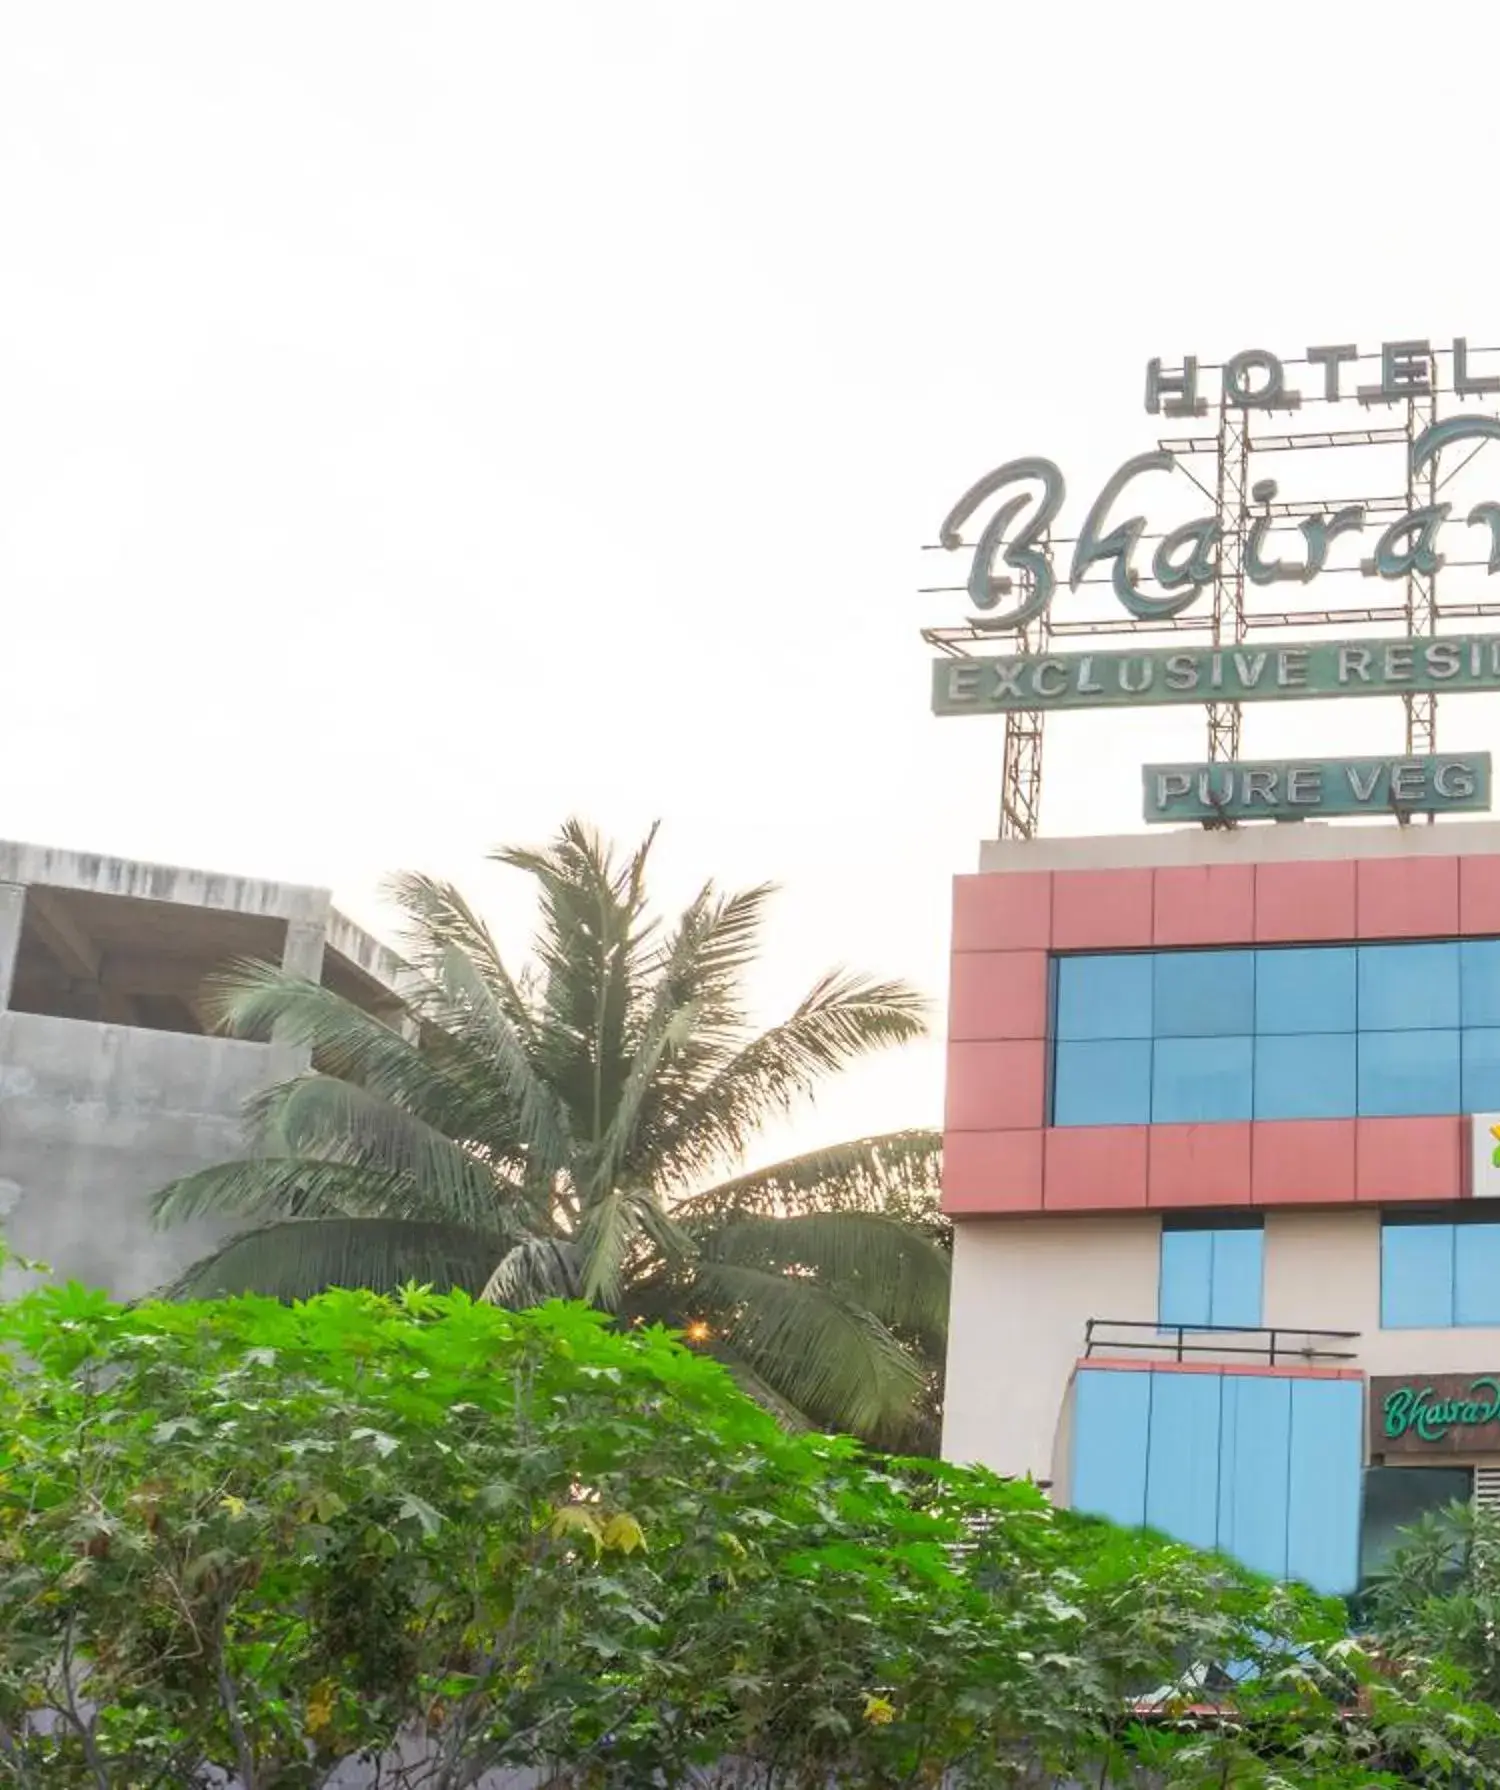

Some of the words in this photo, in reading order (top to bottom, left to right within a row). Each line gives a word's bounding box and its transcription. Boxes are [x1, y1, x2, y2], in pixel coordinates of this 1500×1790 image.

[948, 650, 1311, 700] EXCLUSIVE
[1155, 762, 1321, 806] PURE
[1345, 759, 1475, 799] VEG
